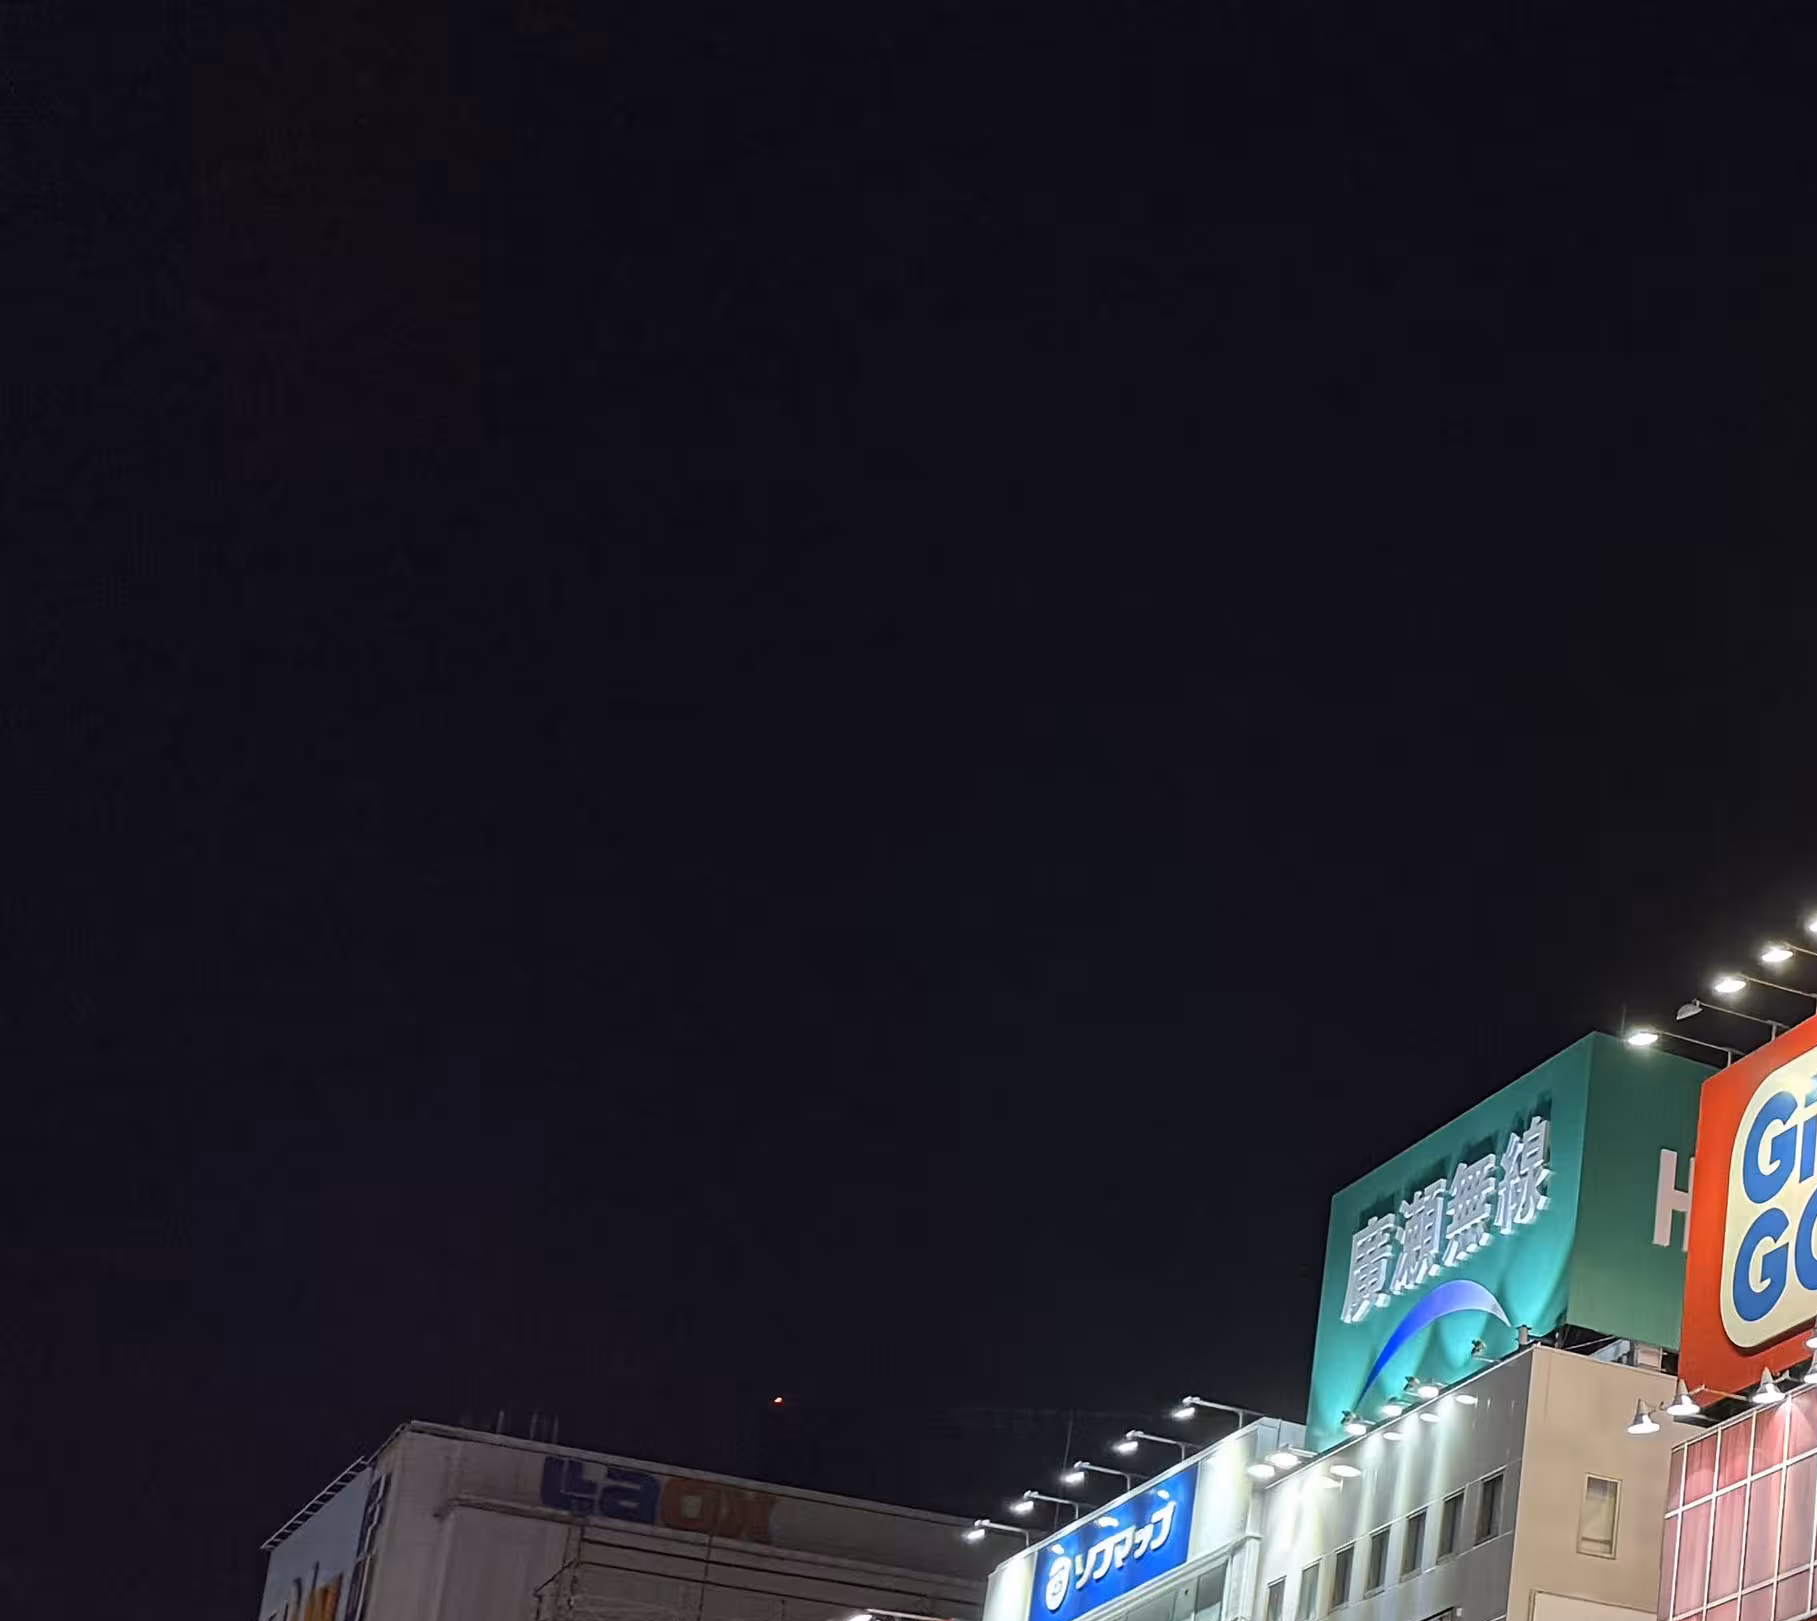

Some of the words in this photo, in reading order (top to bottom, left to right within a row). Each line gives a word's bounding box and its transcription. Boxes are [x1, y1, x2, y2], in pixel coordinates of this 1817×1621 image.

[1339, 1114, 1552, 1325] 廣瀬無線
[1073, 1489, 1177, 1593] ソフマップ
